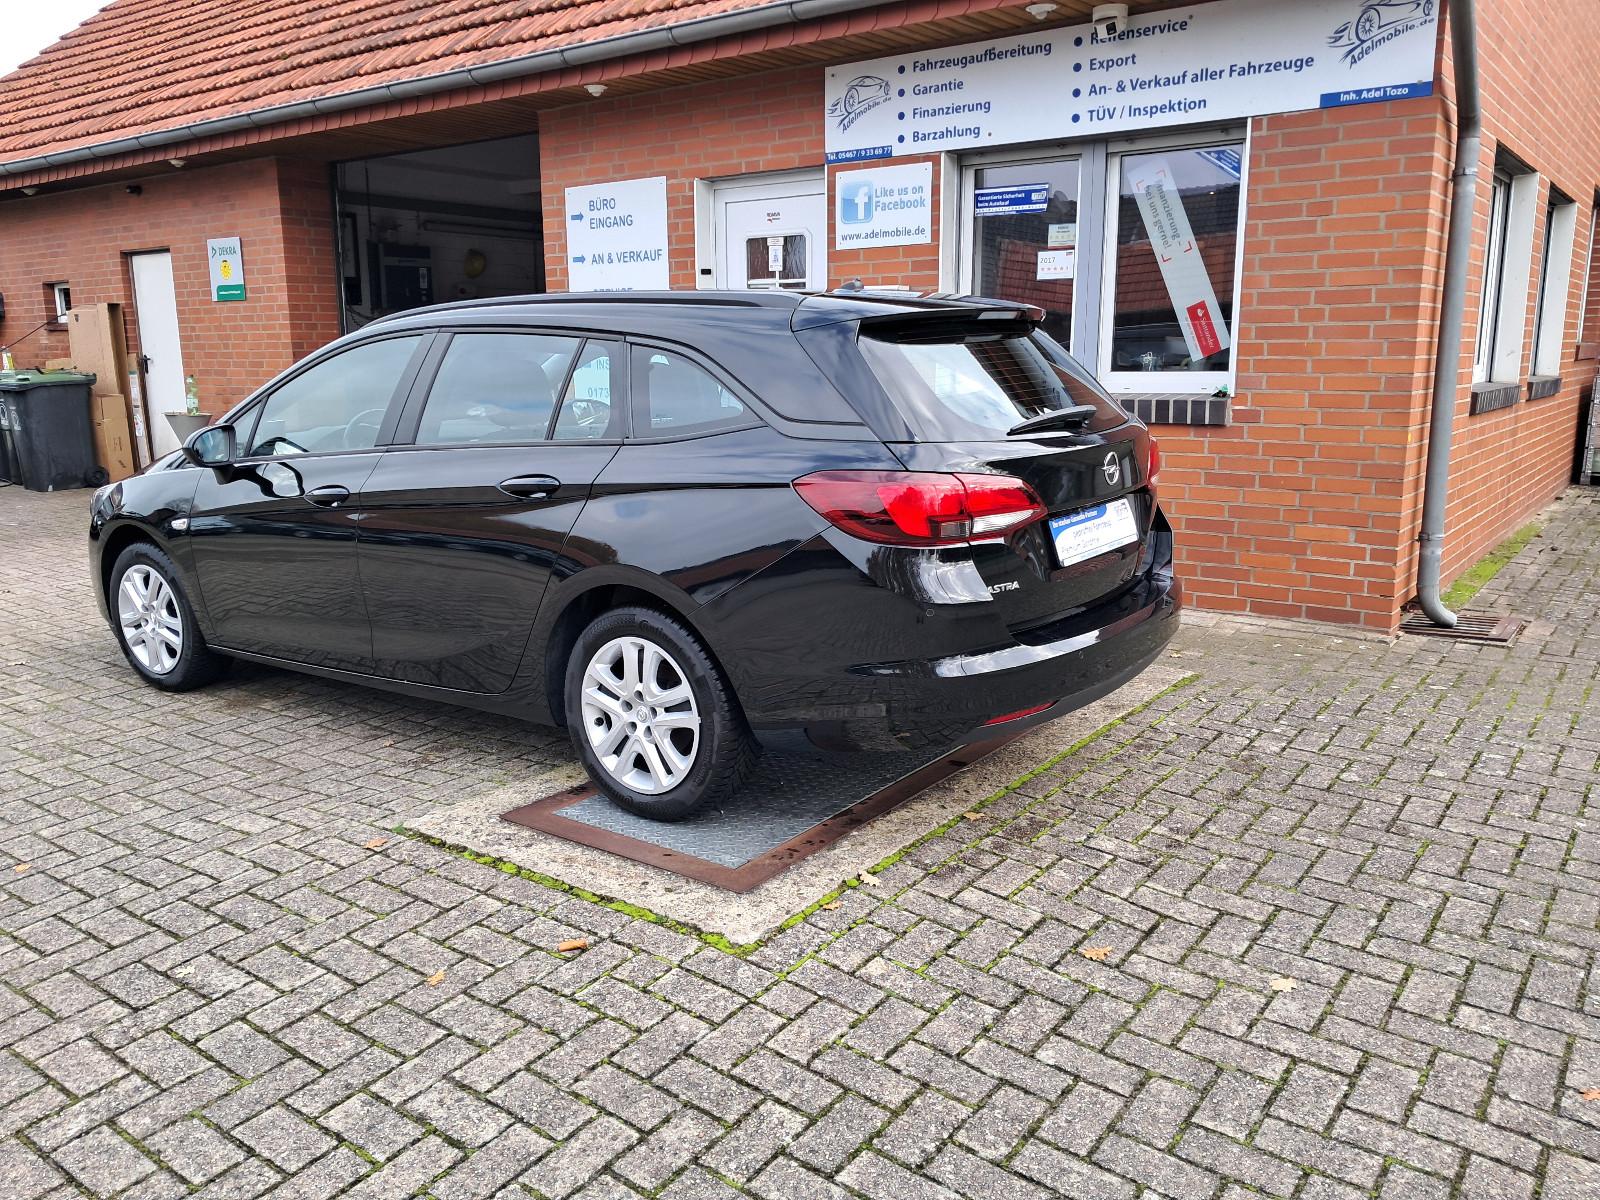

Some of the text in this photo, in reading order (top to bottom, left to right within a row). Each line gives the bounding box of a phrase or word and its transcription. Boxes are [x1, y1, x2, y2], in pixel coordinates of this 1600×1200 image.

[1349, 18, 1435, 70] Adelmobile.de
[912, 41, 1052, 73] Fahrzeugaufbereitung
[1089, 53, 1137, 72] Export
[1088, 56, 1315, 97] An- & Verkauf aller Fahrzeuge
[912, 79, 964, 96] Garantie
[1340, 87, 1409, 102] Inh. Adel Tozo
[842, 96, 892, 134] Adelmobile.de
[912, 100, 991, 119] Finanzierung
[1088, 96, 1207, 122] TÜV / Inspektion
[912, 126, 981, 143] Barzahlung
[827, 153, 838, 161] Tel.
[874, 185, 924, 199] Like us on
[588, 196, 616, 211] BÜRO
[874, 197, 926, 212] Facebook
[1149, 201, 1159, 219] uns
[589, 214, 633, 230] EINGANG
[841, 225, 926, 241] www.adelmobile.de
[1153, 218, 1172, 249] gerne!
[218, 246, 237, 256] DEKRA
[591, 248, 662, 265] AN & VERKAUF
[988, 580, 1020, 594] ASTRA
